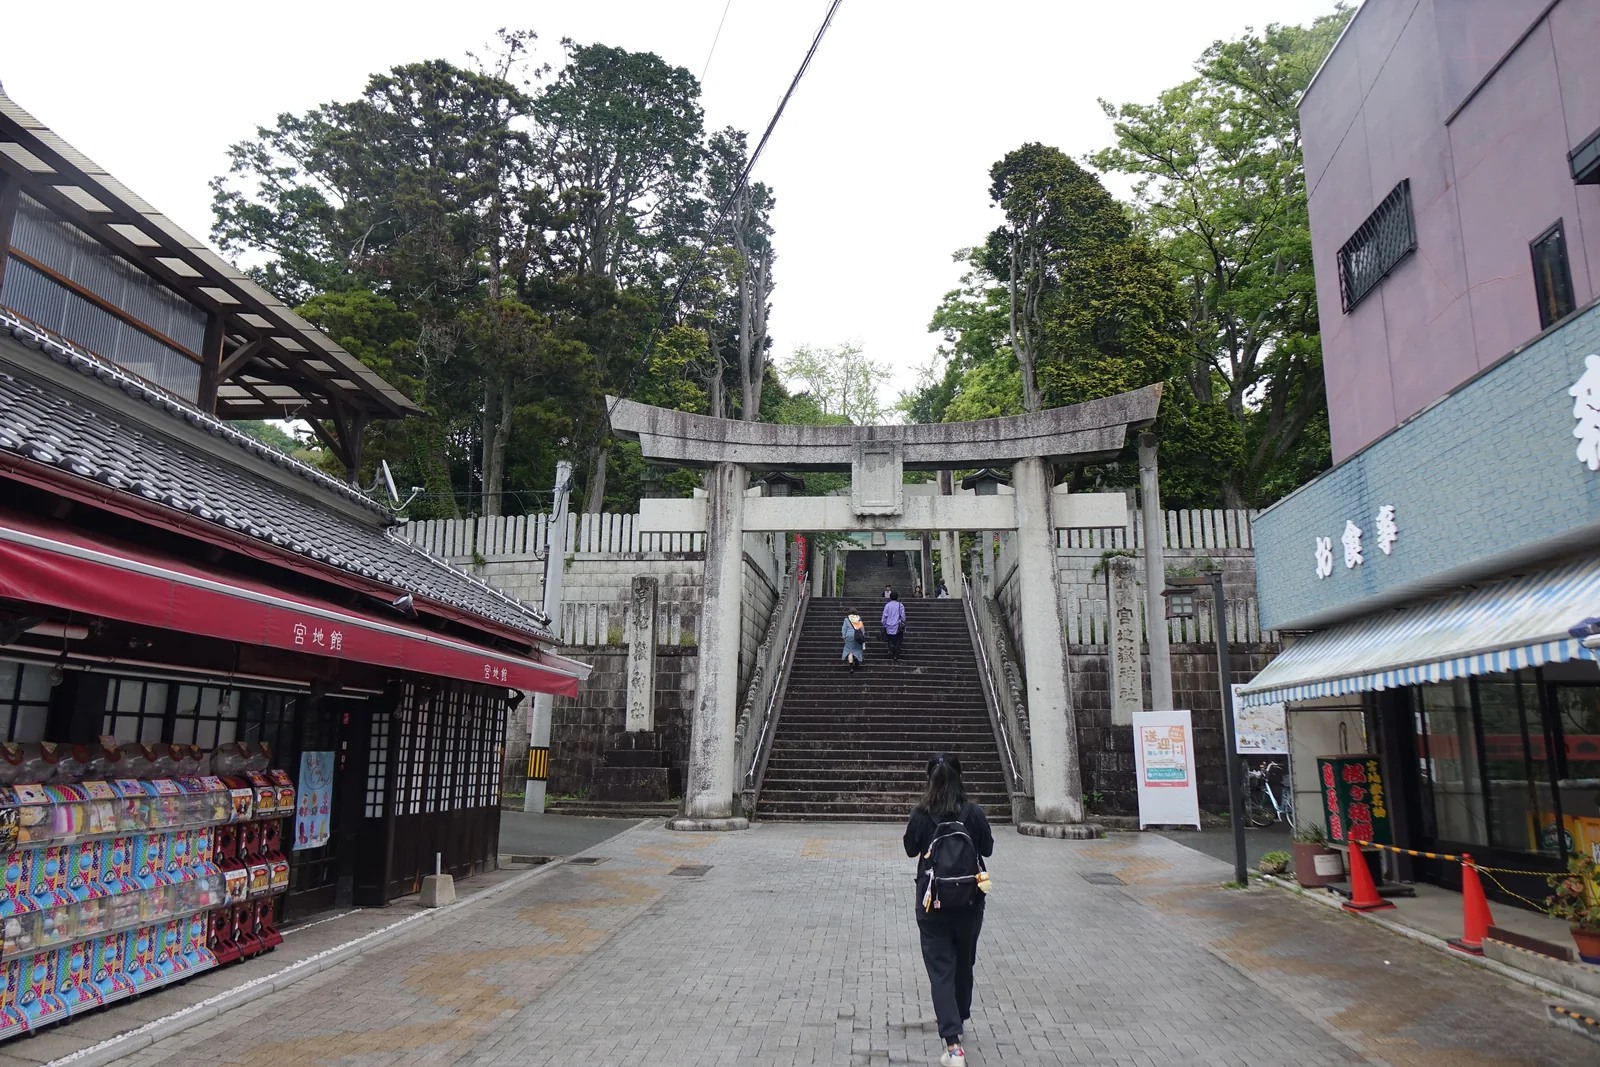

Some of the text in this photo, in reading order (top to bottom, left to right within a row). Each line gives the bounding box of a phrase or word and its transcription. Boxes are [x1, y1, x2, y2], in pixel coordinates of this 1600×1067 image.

[1315, 504, 1398, 579] お食事
[293, 622, 343, 650] 宮地館
[1116, 606, 1138, 704] 宮地嶽神社
[484, 664, 508, 682] 宮地館
